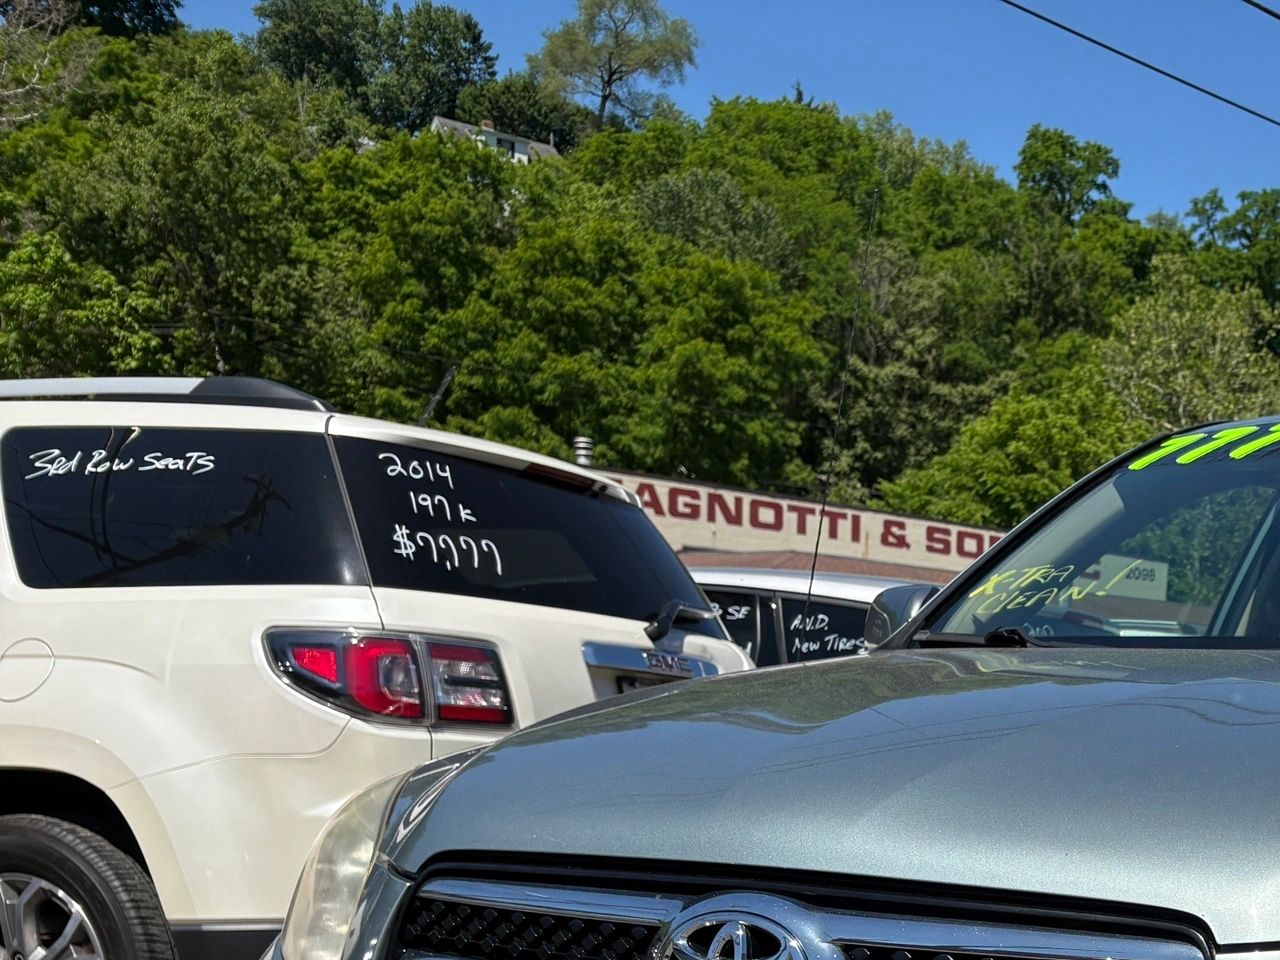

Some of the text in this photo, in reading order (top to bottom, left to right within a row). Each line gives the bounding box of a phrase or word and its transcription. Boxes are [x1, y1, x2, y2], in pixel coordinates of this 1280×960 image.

[378, 452, 455, 490] 2014
[409, 490, 452, 521] 197
[606, 477, 861, 543] AGNOTTI
[880, 519, 911, 550] &
